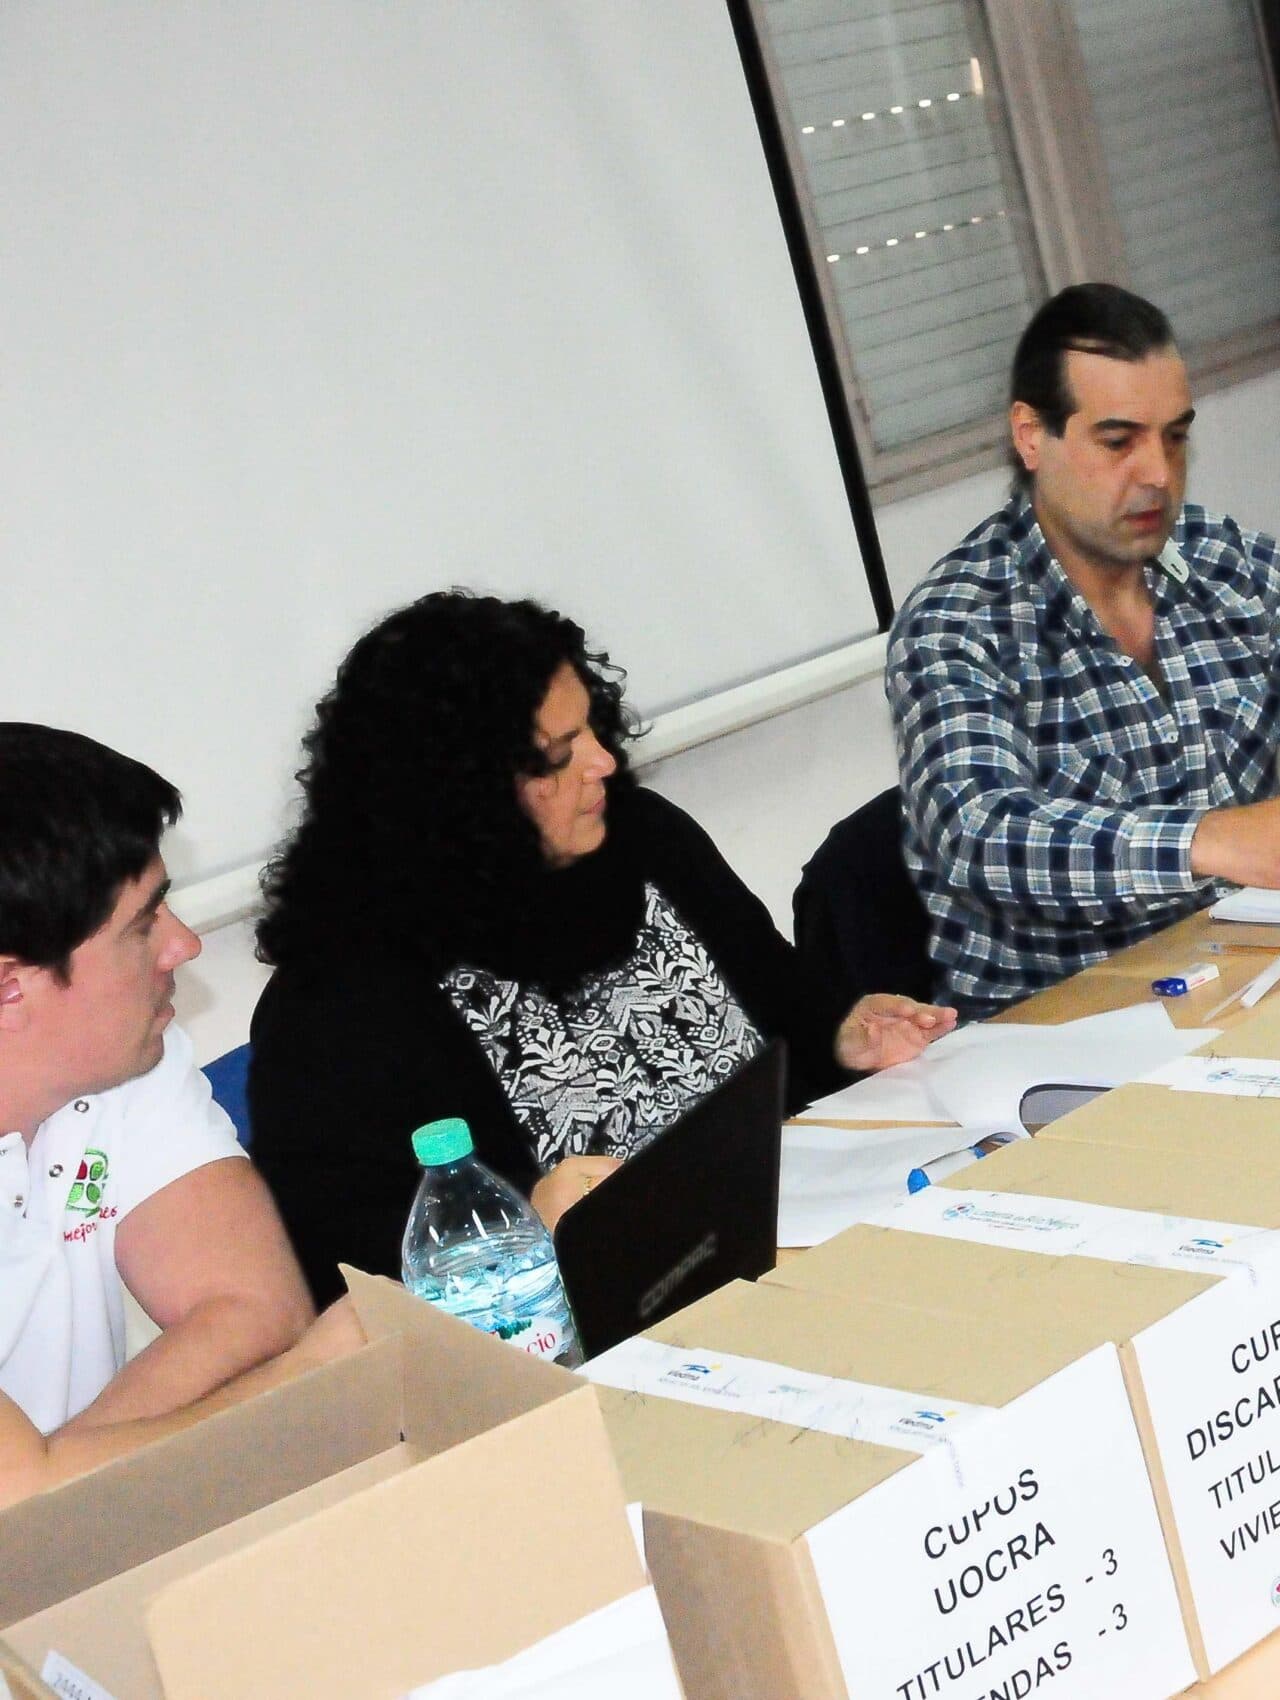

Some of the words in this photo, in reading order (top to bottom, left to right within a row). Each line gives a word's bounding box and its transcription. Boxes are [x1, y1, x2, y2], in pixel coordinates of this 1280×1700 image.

[924, 1468, 1039, 1560] CUPOS
[933, 1521, 1056, 1615] UOCRA
[896, 1583, 1066, 1700] TITULARES
[977, 1641, 1072, 1700] NDAS
